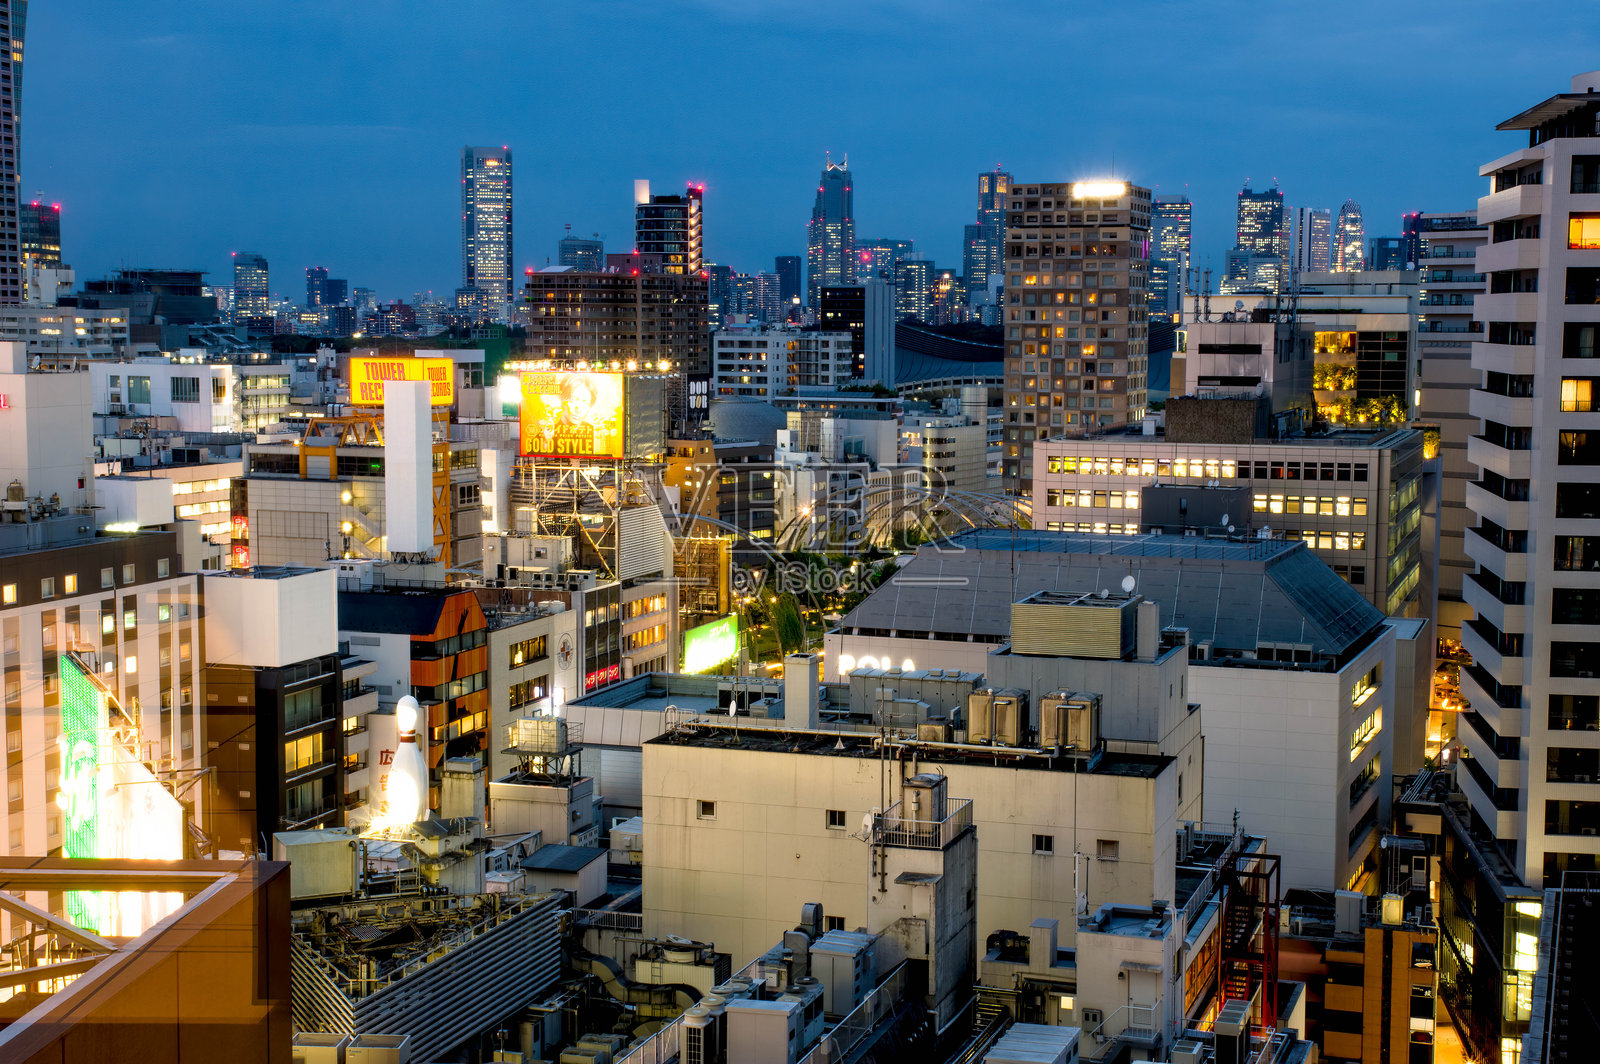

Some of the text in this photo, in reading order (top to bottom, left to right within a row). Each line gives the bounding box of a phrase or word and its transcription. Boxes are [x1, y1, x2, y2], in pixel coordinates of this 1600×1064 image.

[363, 362, 406, 381] TOWER
[427, 367, 447, 381] TOWER
[431, 382, 451, 397] CORDS
[689, 380, 708, 395] DOU
[689, 395, 708, 409] TOR
[525, 437, 593, 454] GOLD STYLE
